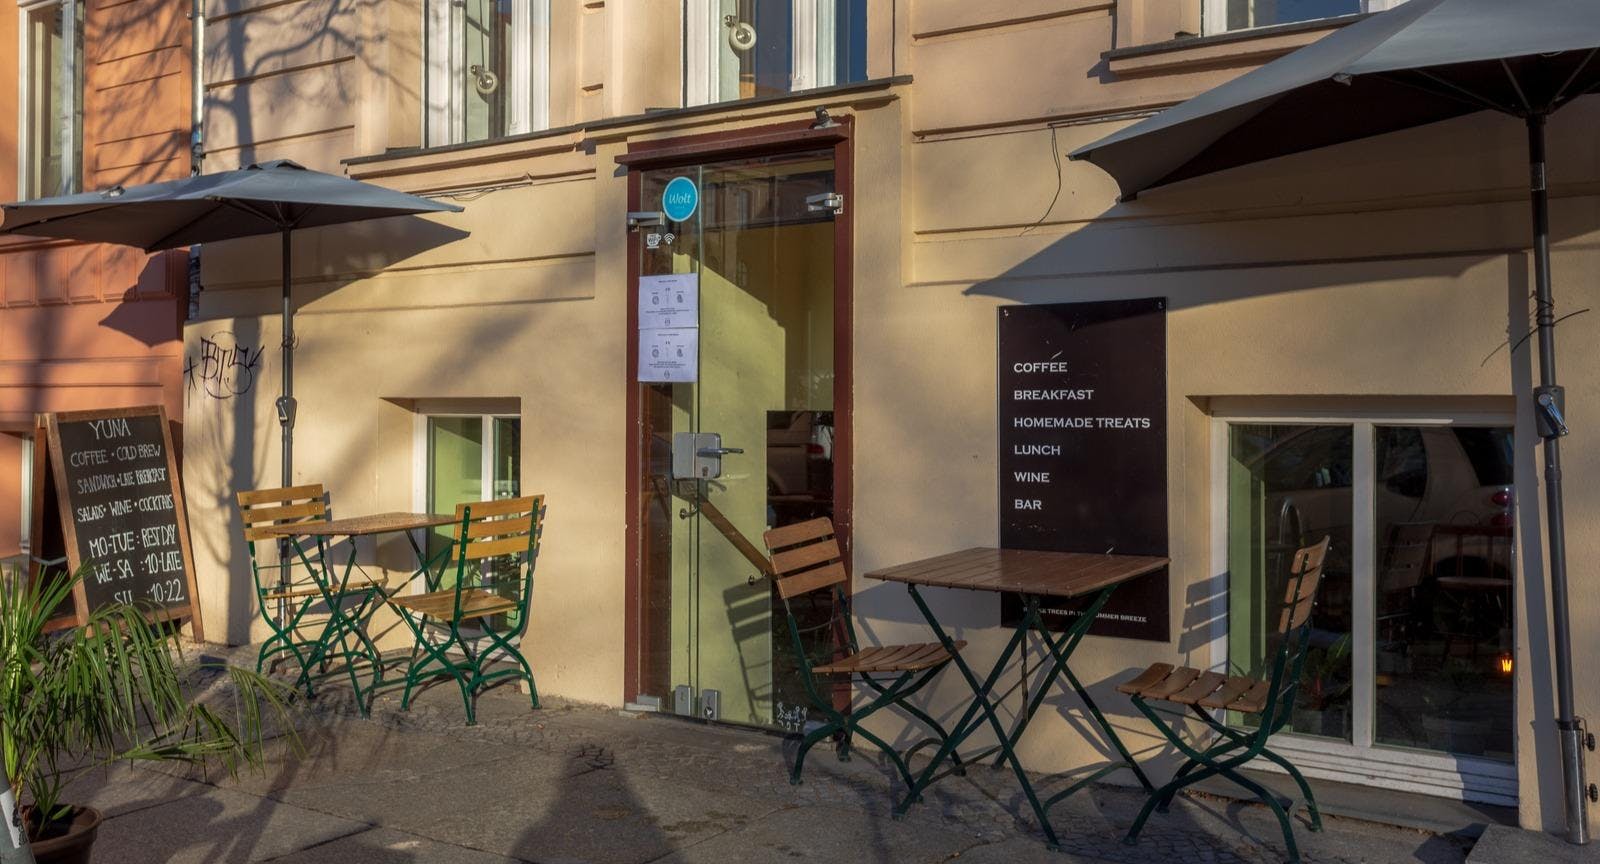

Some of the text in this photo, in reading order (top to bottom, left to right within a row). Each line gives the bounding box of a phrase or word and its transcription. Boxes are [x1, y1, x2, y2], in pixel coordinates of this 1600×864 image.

[669, 192, 691, 205] Wolt
[1013, 361, 1068, 373] COFFEE
[1013, 389, 1095, 401] BREAKFAST
[88, 418, 131, 440] YUNA
[1013, 417, 1151, 429] HOMEMADE TREATS
[70, 443, 161, 467] COFFEE COLD BREW
[1014, 444, 1061, 456] LUNCH
[77, 473, 117, 494] SANDWICH
[1013, 472, 1050, 484] WINE
[77, 504, 105, 522] SALADS
[108, 499, 133, 516] WINE
[1014, 499, 1042, 511] BAR
[141, 526, 160, 548] REST
[160, 524, 176, 546] DAY
[1095, 612, 1119, 621] UMMER
